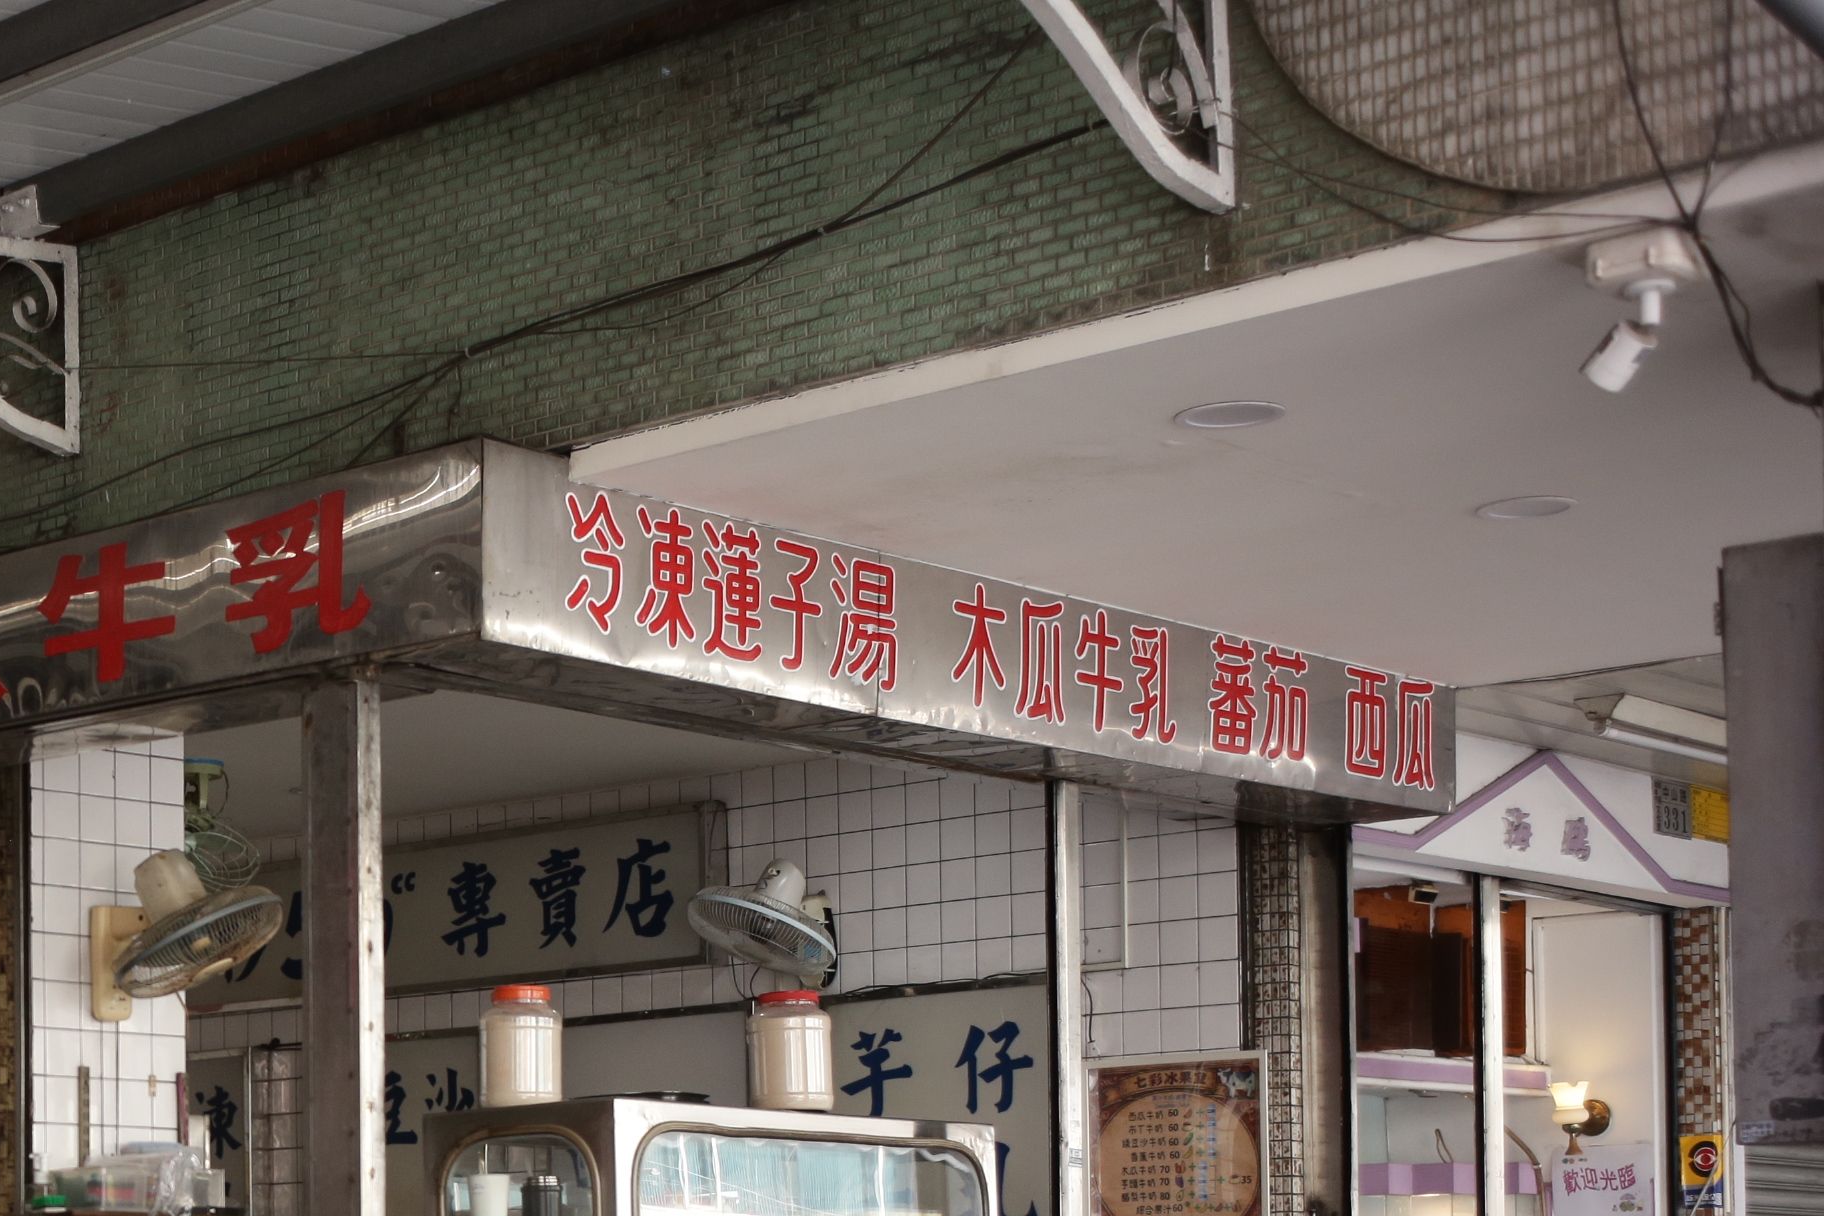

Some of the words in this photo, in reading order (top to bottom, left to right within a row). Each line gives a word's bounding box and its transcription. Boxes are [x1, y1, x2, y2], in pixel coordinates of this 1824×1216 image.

[565, 489, 899, 694] 冷凍蓮子湯
[952, 583, 1177, 746] 木瓜牛乳
[1209, 633, 1308, 762] 蕃茄
[1344, 663, 1436, 791] 西瓜
[1663, 805, 1689, 834] 331
[1136, 1071, 1207, 1088] 七彩冰果室
[1128, 1109, 1164, 1121] 西瓜牛奶
[1561, 1163, 1637, 1196] 歡迎光臨
